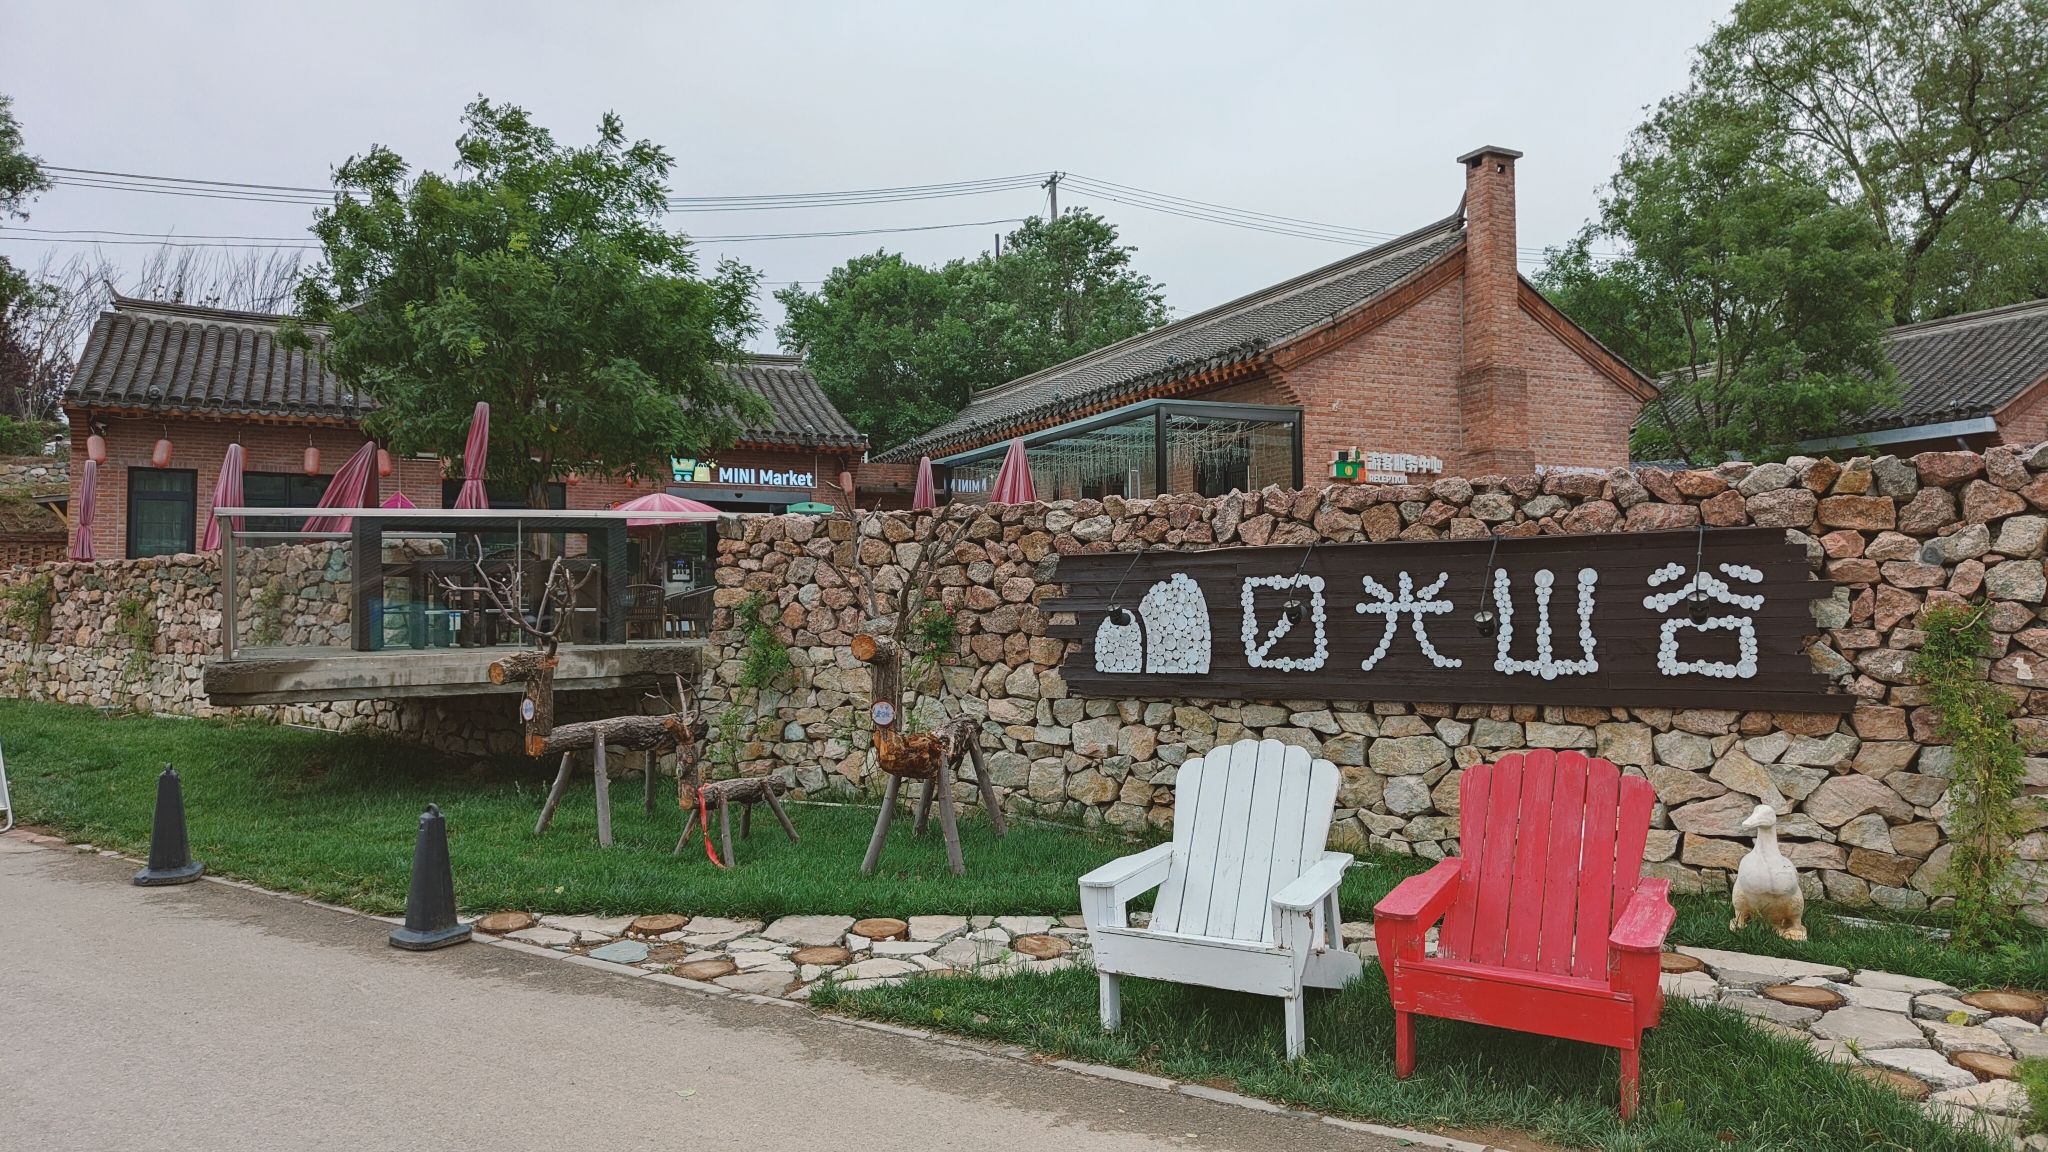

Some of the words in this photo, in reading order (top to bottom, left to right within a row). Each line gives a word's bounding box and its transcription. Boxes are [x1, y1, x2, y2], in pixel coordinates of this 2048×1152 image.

[1367, 451, 1443, 473] 游客服务中心
[719, 467, 756, 484] MINI
[760, 469, 813, 487] Market
[1369, 475, 1408, 484] RECEPTION
